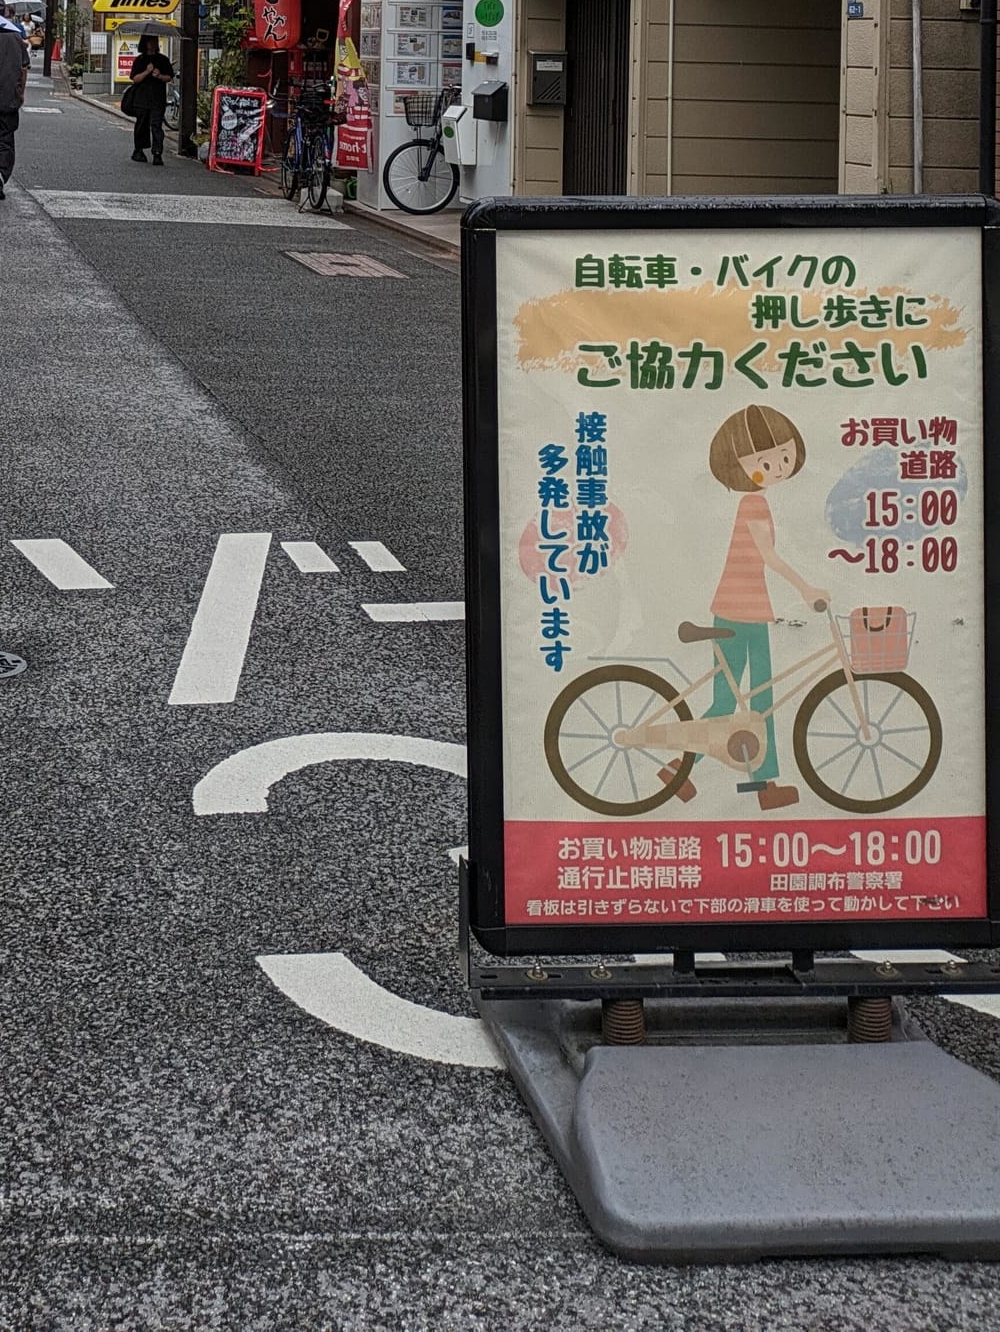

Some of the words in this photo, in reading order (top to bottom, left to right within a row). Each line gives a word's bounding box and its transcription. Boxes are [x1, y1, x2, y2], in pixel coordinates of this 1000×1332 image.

[262, 6, 288, 43] やかん
[575, 254, 857, 289] 自転車・バイクの
[751, 295, 928, 329] 押し歩きに
[576, 340, 928, 390] ご協力ください
[840, 416, 957, 447] お買い物
[900, 451, 957, 479] 道路
[575, 412, 608, 574] 接触事故が
[865, 490, 957, 527] 15:00
[538, 444, 572, 672] 多発しています
[557, 837, 702, 861] お買い物道路
[557, 865, 702, 890] 通行止時間帯
[770, 871, 903, 892] 田園調布警察署
[526, 895, 960, 917] 看板は引きずらないで下部の滑車を使って動かして下さい
